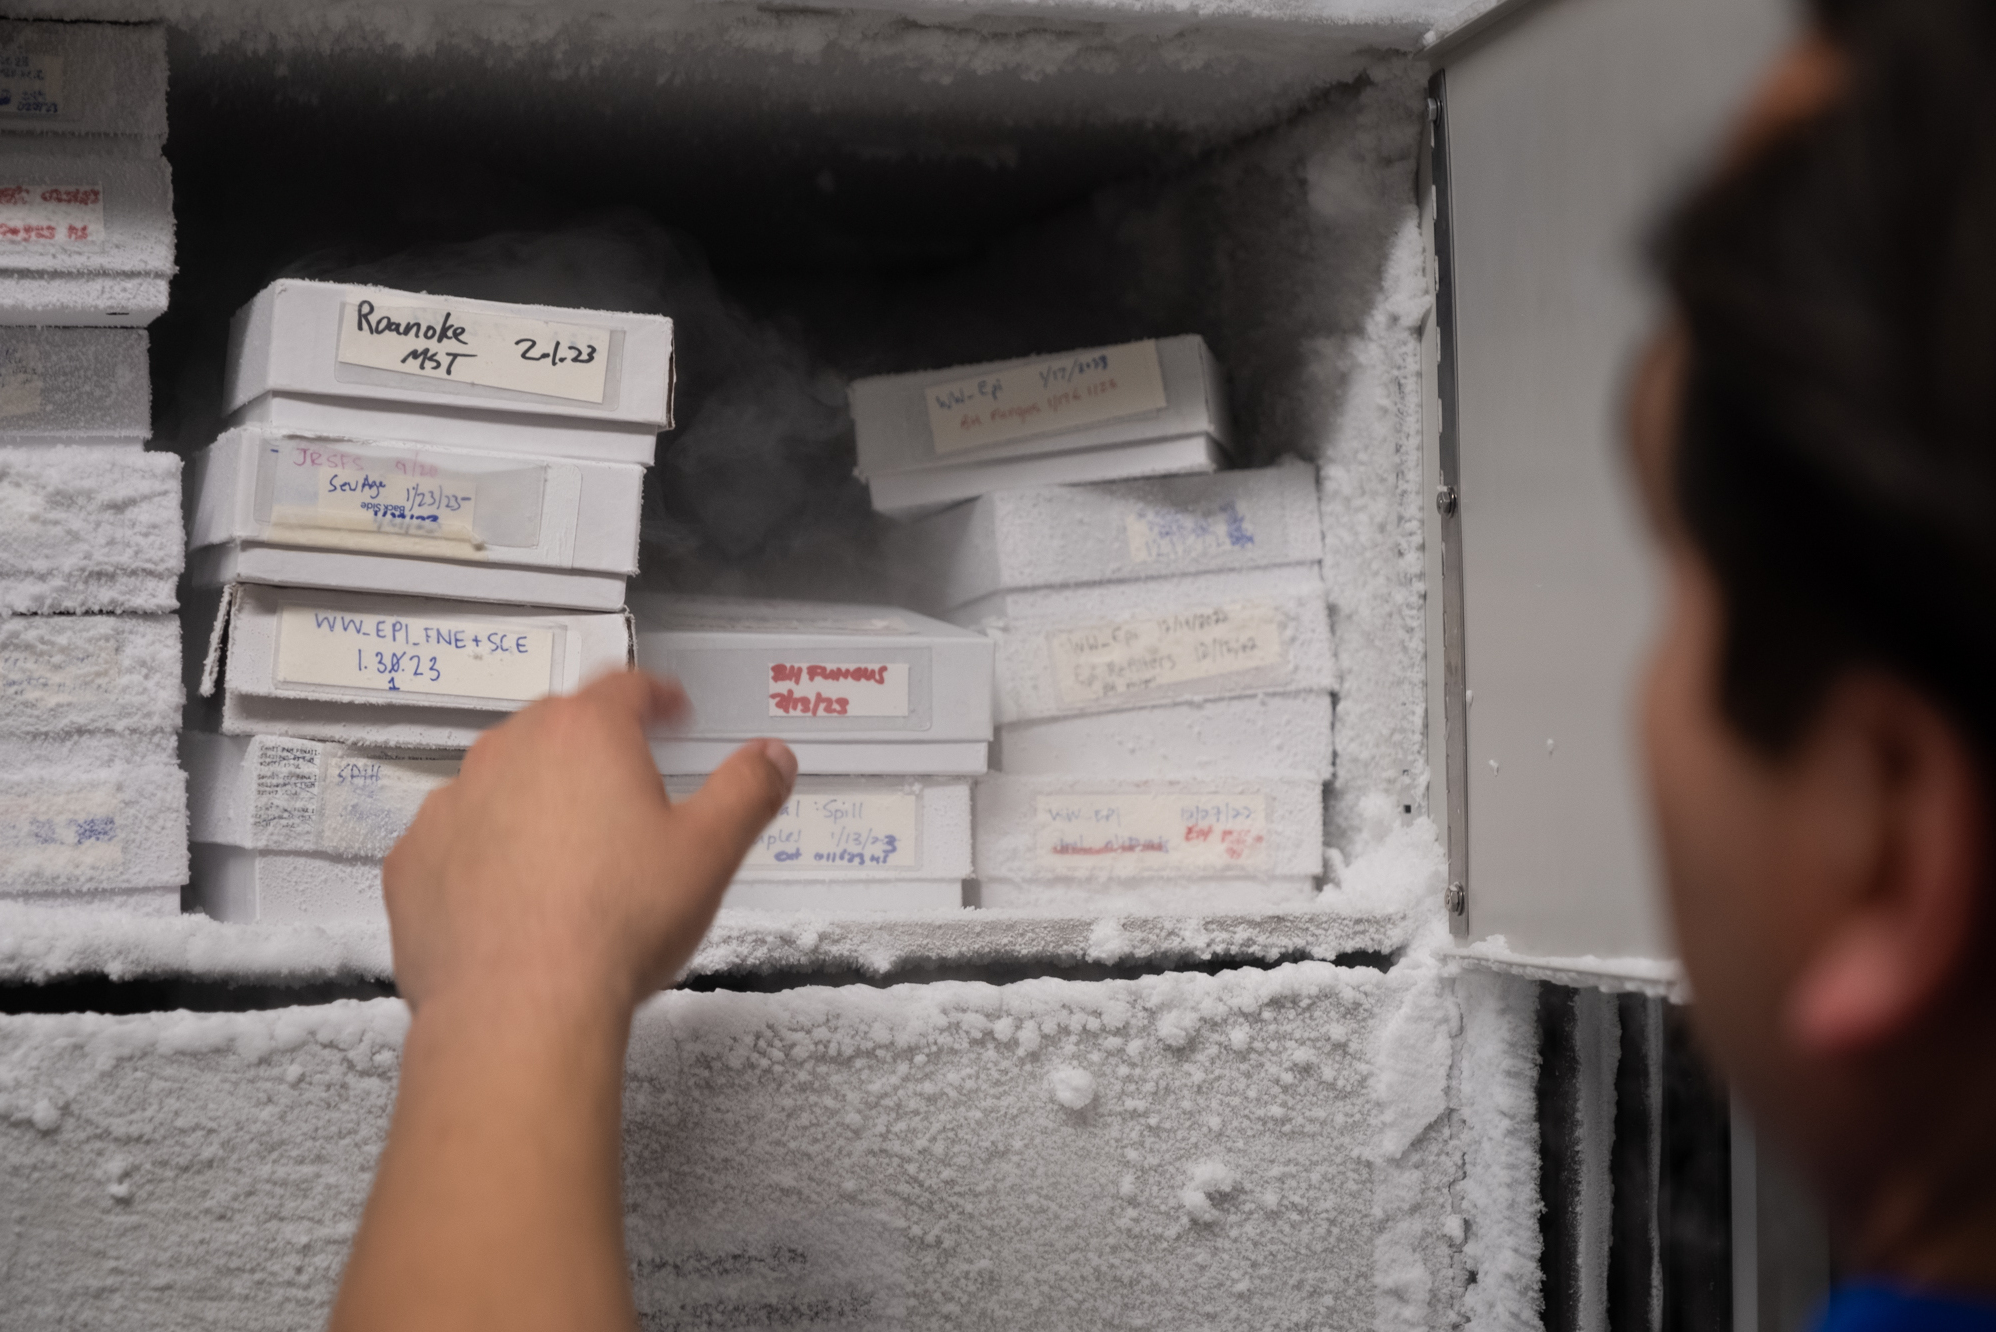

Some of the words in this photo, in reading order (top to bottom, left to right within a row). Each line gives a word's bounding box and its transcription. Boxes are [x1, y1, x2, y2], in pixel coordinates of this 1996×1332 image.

[357, 300, 468, 345] Roanoke
[401, 347, 477, 375] MST
[360, 501, 382, 513] Side
[384, 503, 406, 514] Back
[822, 799, 864, 825] Spill
